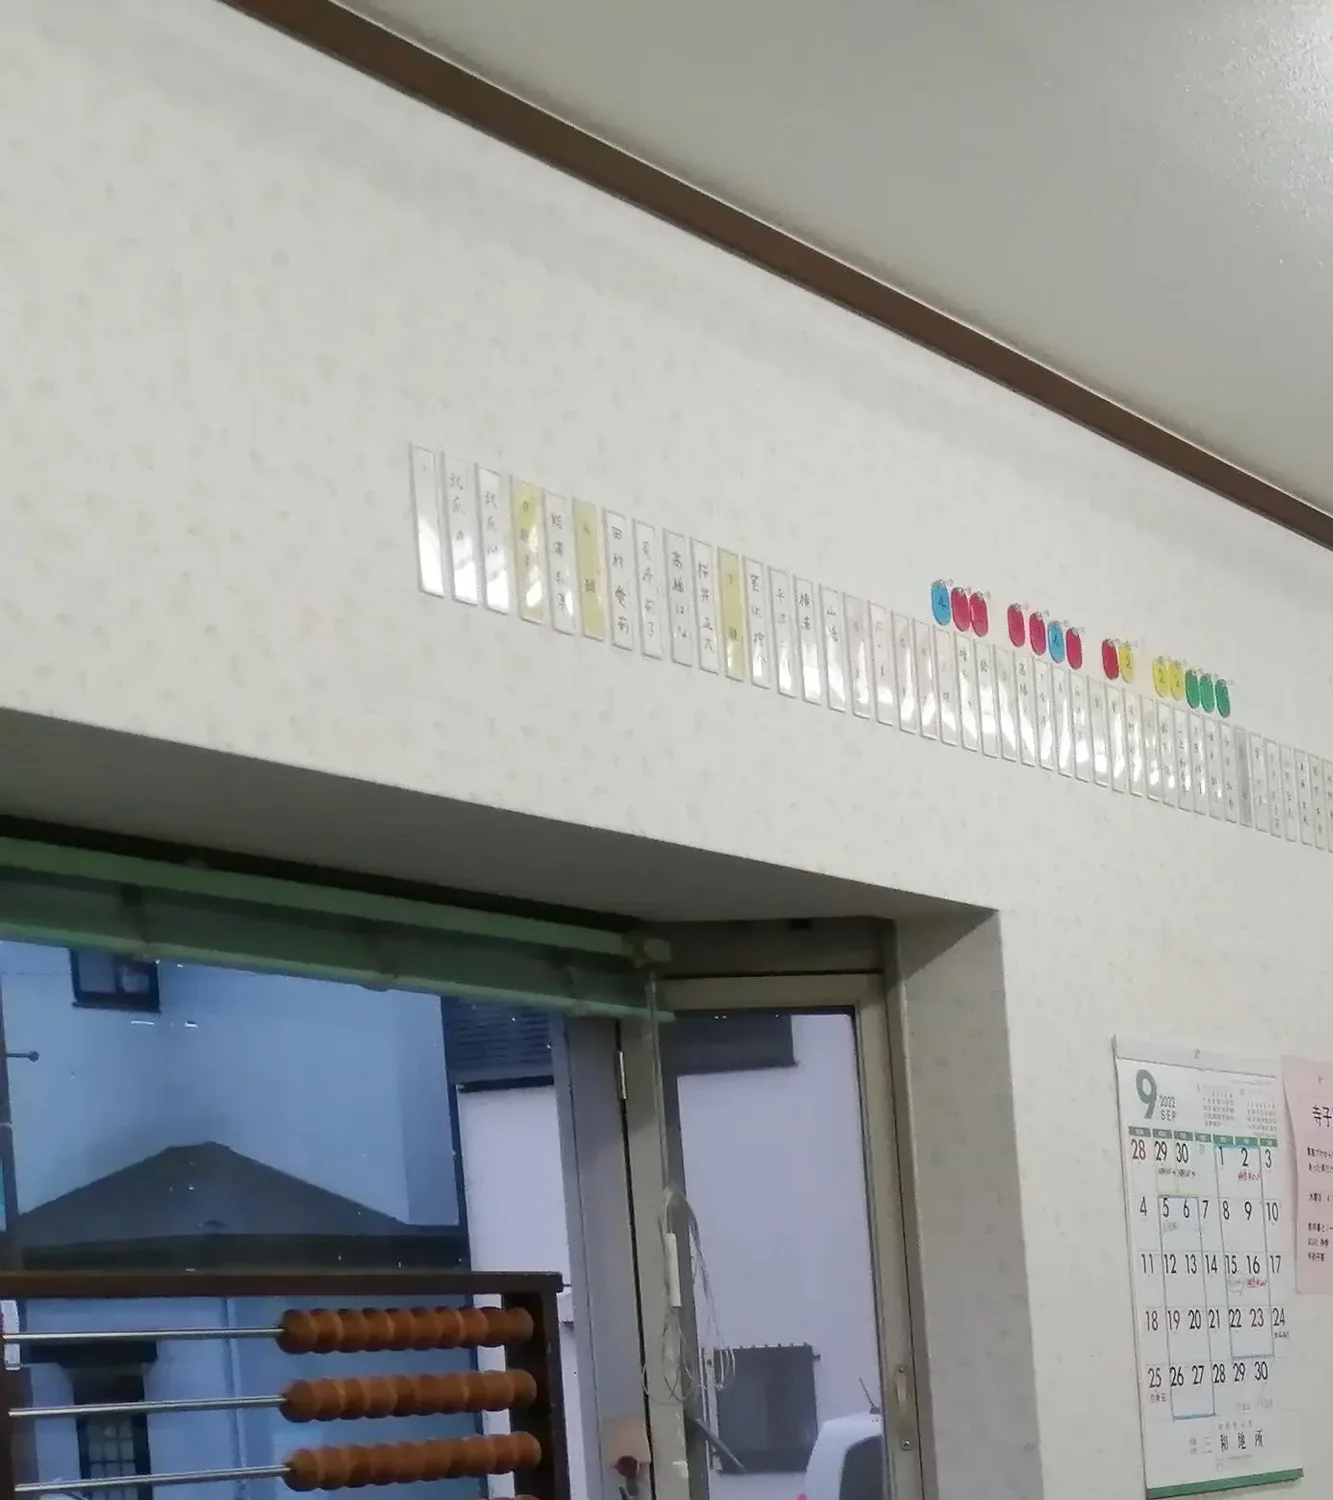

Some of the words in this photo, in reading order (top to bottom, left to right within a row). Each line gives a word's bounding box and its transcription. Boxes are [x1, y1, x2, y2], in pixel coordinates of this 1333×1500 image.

[1135, 1069, 1157, 1119] 9
[1159, 1096, 1177, 1109] 2022
[1131, 1139, 1147, 1161] 28
[1154, 1141, 1168, 1162] 29
[1175, 1142, 1189, 1163] 30
[1219, 1146, 1224, 1166] 1
[1240, 1147, 1249, 1167] 2
[1265, 1149, 1272, 1169] 3
[1139, 1196, 1148, 1216] 4
[1162, 1197, 1170, 1218] 5
[1183, 1199, 1190, 1219] 6
[1202, 1200, 1209, 1219] 7
[1223, 1200, 1230, 1220] 8
[1244, 1201, 1252, 1221] 9
[1266, 1202, 1279, 1222] 10
[1141, 1253, 1154, 1274] 11
[1164, 1253, 1177, 1274] 12
[1184, 1253, 1198, 1274] 13
[1205, 1254, 1218, 1274] 14
[1225, 1255, 1238, 1275] 15
[1246, 1255, 1261, 1274] 16
[1270, 1255, 1282, 1274] 17
[1145, 1310, 1159, 1331] 18
[1167, 1310, 1181, 1331] 19
[1188, 1309, 1202, 1330] 20
[1208, 1309, 1221, 1329] 21
[1228, 1308, 1243, 1328] 22
[1249, 1308, 1264, 1328] 23
[1272, 1307, 1286, 1327] 24
[1148, 1367, 1162, 1388] 25
[1170, 1366, 1185, 1387] 26
[1192, 1365, 1204, 1385] 27
[1212, 1363, 1226, 1384] 28
[1232, 1362, 1246, 1382] 29
[1254, 1361, 1269, 1381] 30
